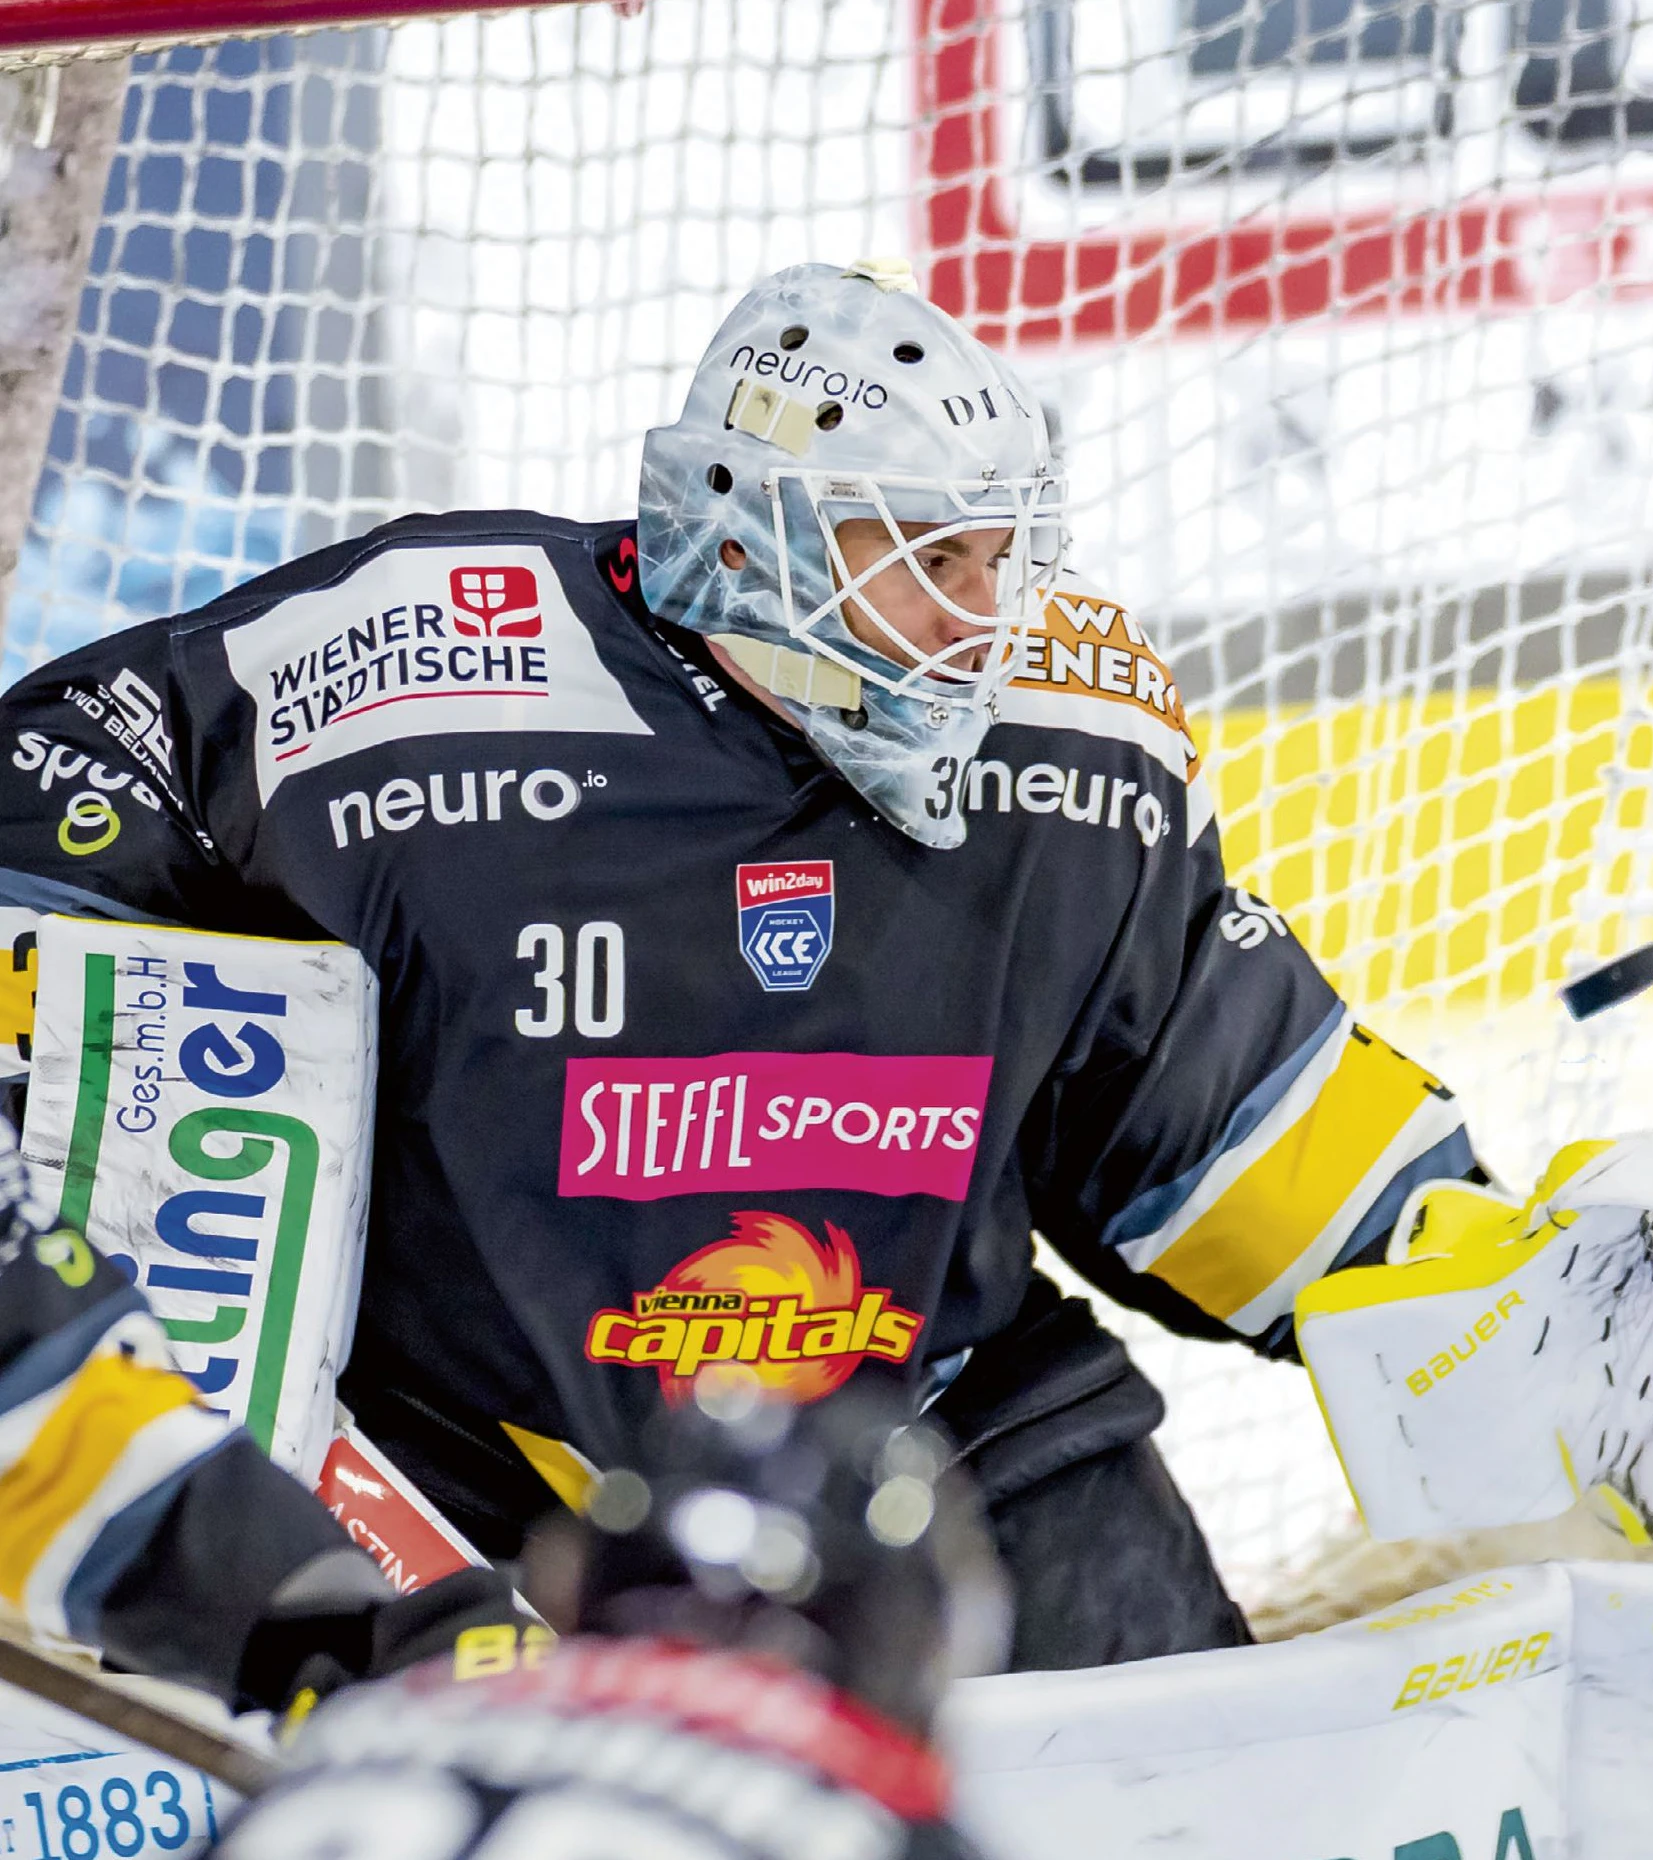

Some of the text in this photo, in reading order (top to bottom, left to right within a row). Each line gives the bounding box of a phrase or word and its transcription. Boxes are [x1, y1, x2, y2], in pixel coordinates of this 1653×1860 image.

[729, 345, 888, 409] neuro.io
[270, 604, 446, 701] WIENER
[1052, 596, 1156, 652] WI
[270, 646, 549, 745] STÄDTISCHE
[755, 931, 817, 966] ICE
[769, 918, 804, 926] HOCKEY
[515, 921, 625, 1038] 30
[577, 1075, 980, 1178] STEFFL SPORTS
[590, 1292, 918, 1376] capitals
[638, 1287, 743, 1316] vienna
[24, 1770, 190, 1860] 1883
